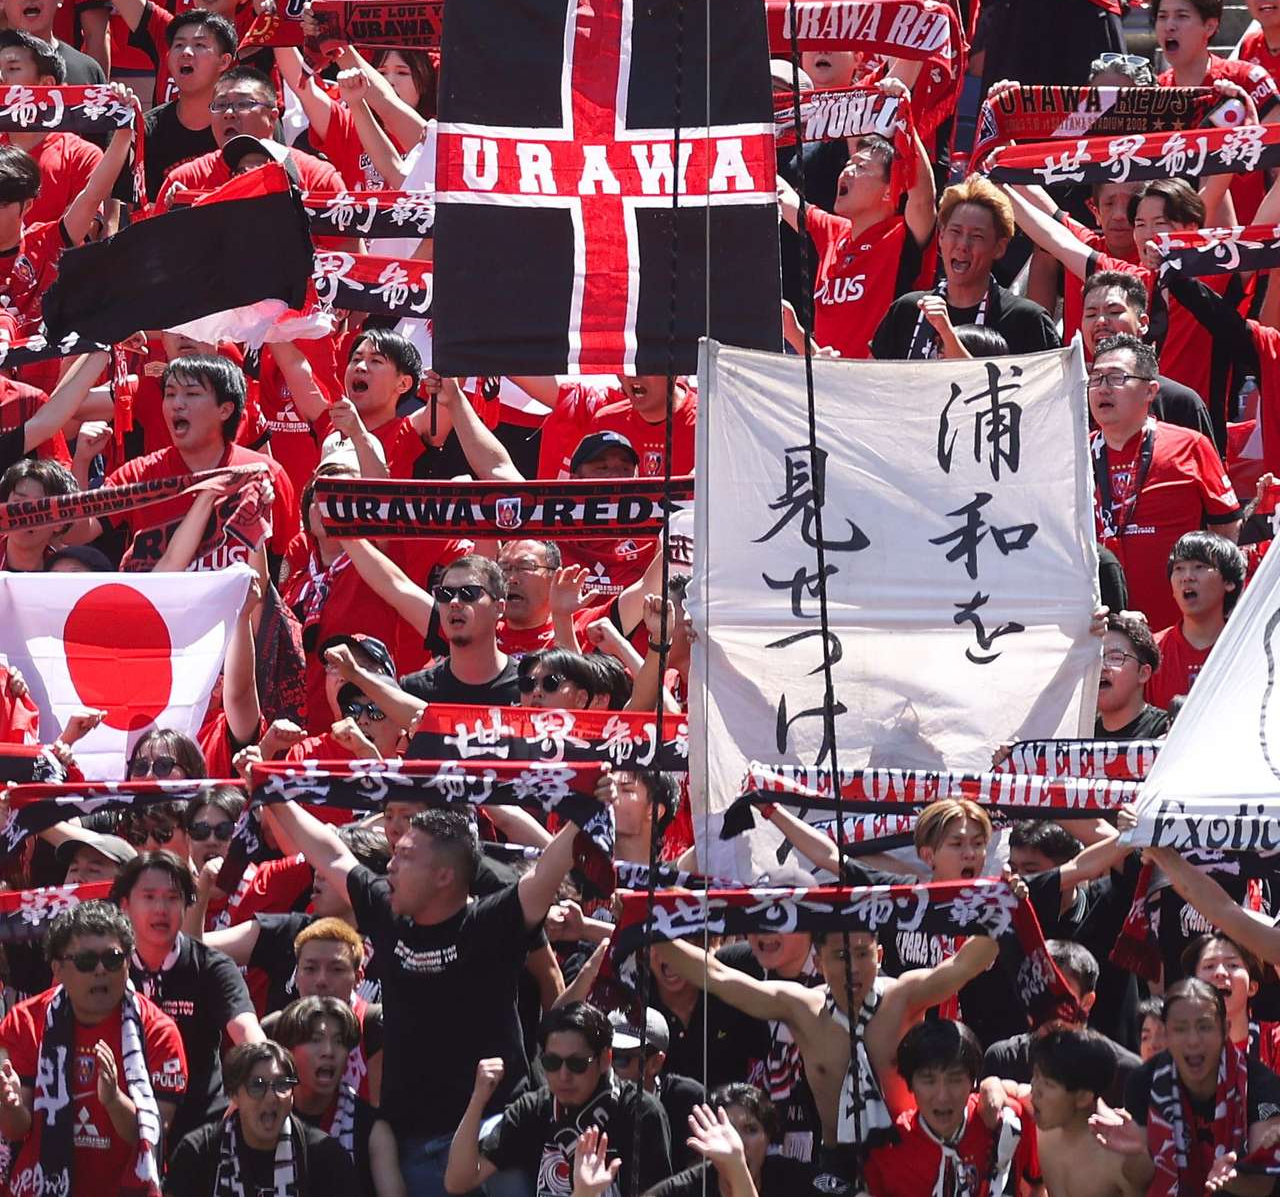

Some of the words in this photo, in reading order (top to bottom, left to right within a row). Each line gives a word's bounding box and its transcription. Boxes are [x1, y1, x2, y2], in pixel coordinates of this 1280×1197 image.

[462, 137, 755, 195] URAWA
[1034, 125, 1267, 185] 世界制覇
[331, 498, 485, 525] URAWA
[930, 362, 1038, 665] 浦和を
[752, 443, 870, 769] 見せつけ
[265, 759, 577, 807] 世界制覇
[648, 880, 1017, 939] 世界制覇
